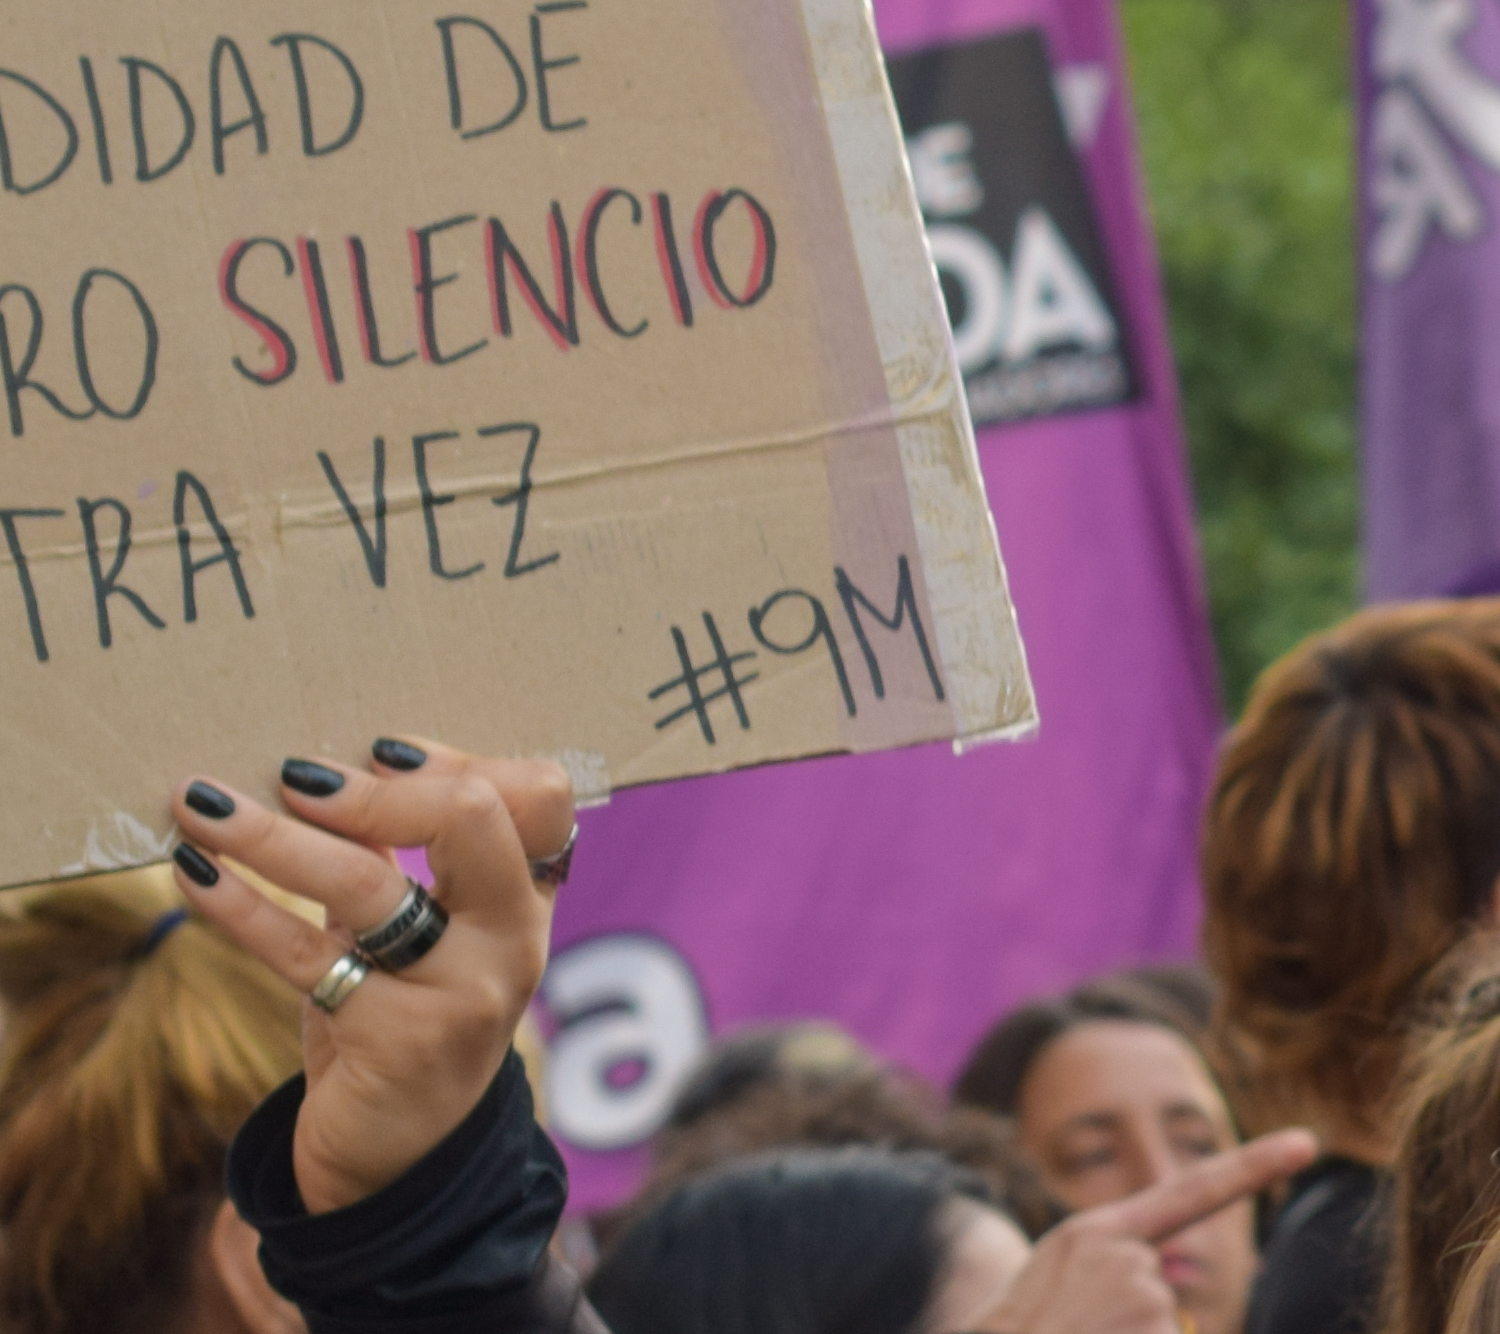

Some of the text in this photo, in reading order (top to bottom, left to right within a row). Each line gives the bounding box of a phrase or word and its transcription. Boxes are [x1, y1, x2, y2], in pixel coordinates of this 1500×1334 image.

[0, 1, 589, 195] DIDAD DE
[218, 187, 777, 388] SILENCIO
[317, 423, 561, 589] VEZ
[648, 554, 945, 745] #9M
